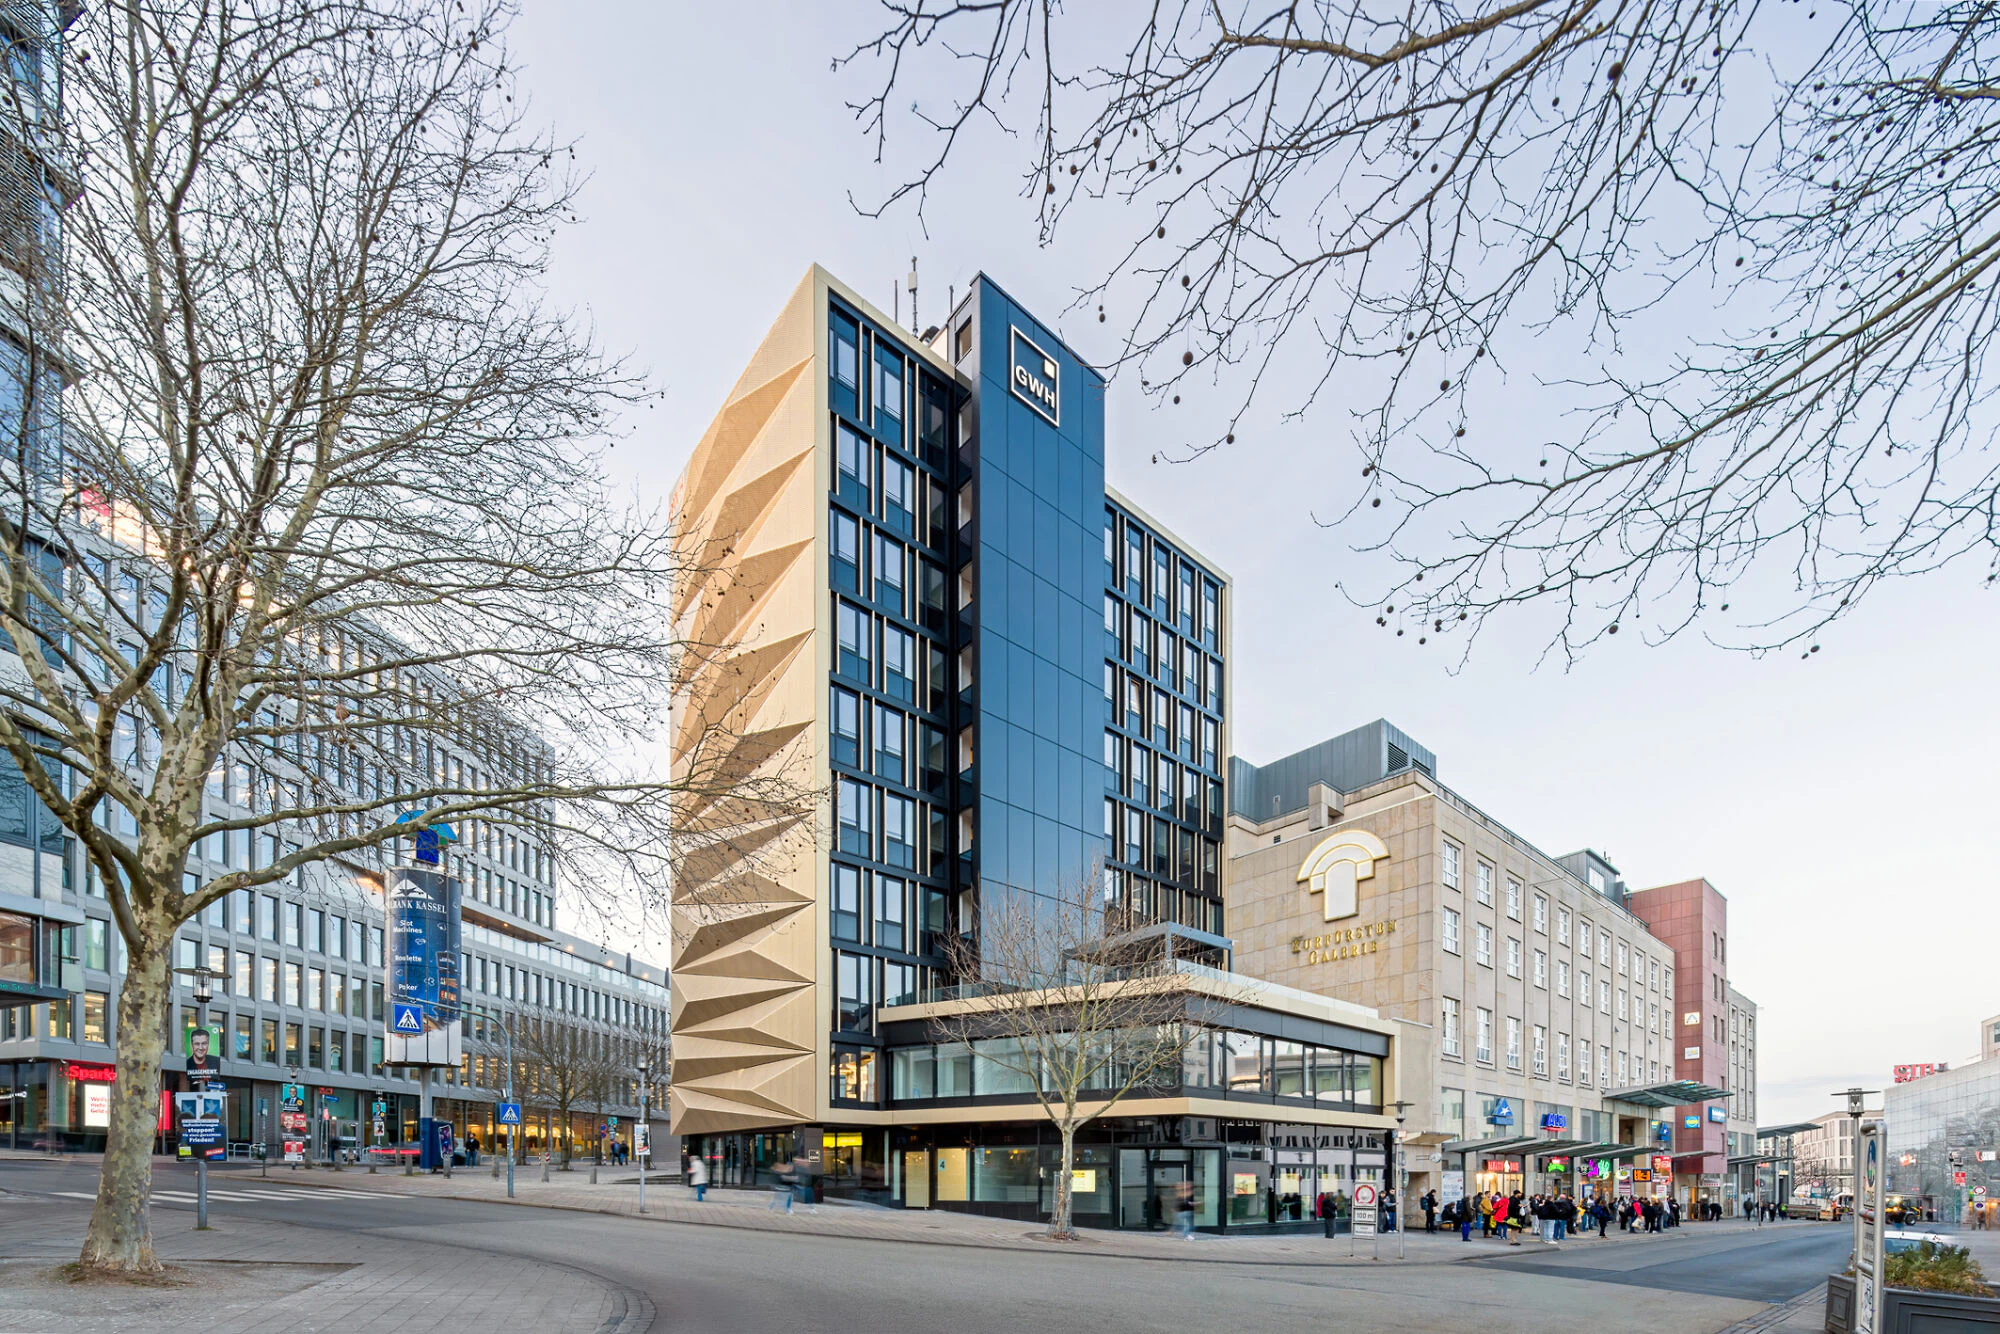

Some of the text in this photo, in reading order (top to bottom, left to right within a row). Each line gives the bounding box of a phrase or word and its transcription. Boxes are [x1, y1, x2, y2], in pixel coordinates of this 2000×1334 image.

[1015, 364, 1056, 408] GWH
[416, 900, 447, 914] KASSEL
[399, 919, 414, 927] Slot
[392, 926, 423, 934] Machines
[1308, 940, 1377, 965] GALERIE
[394, 954, 422, 962] Roulette
[398, 983, 418, 991] Poker
[939, 1161, 945, 1169] 4
